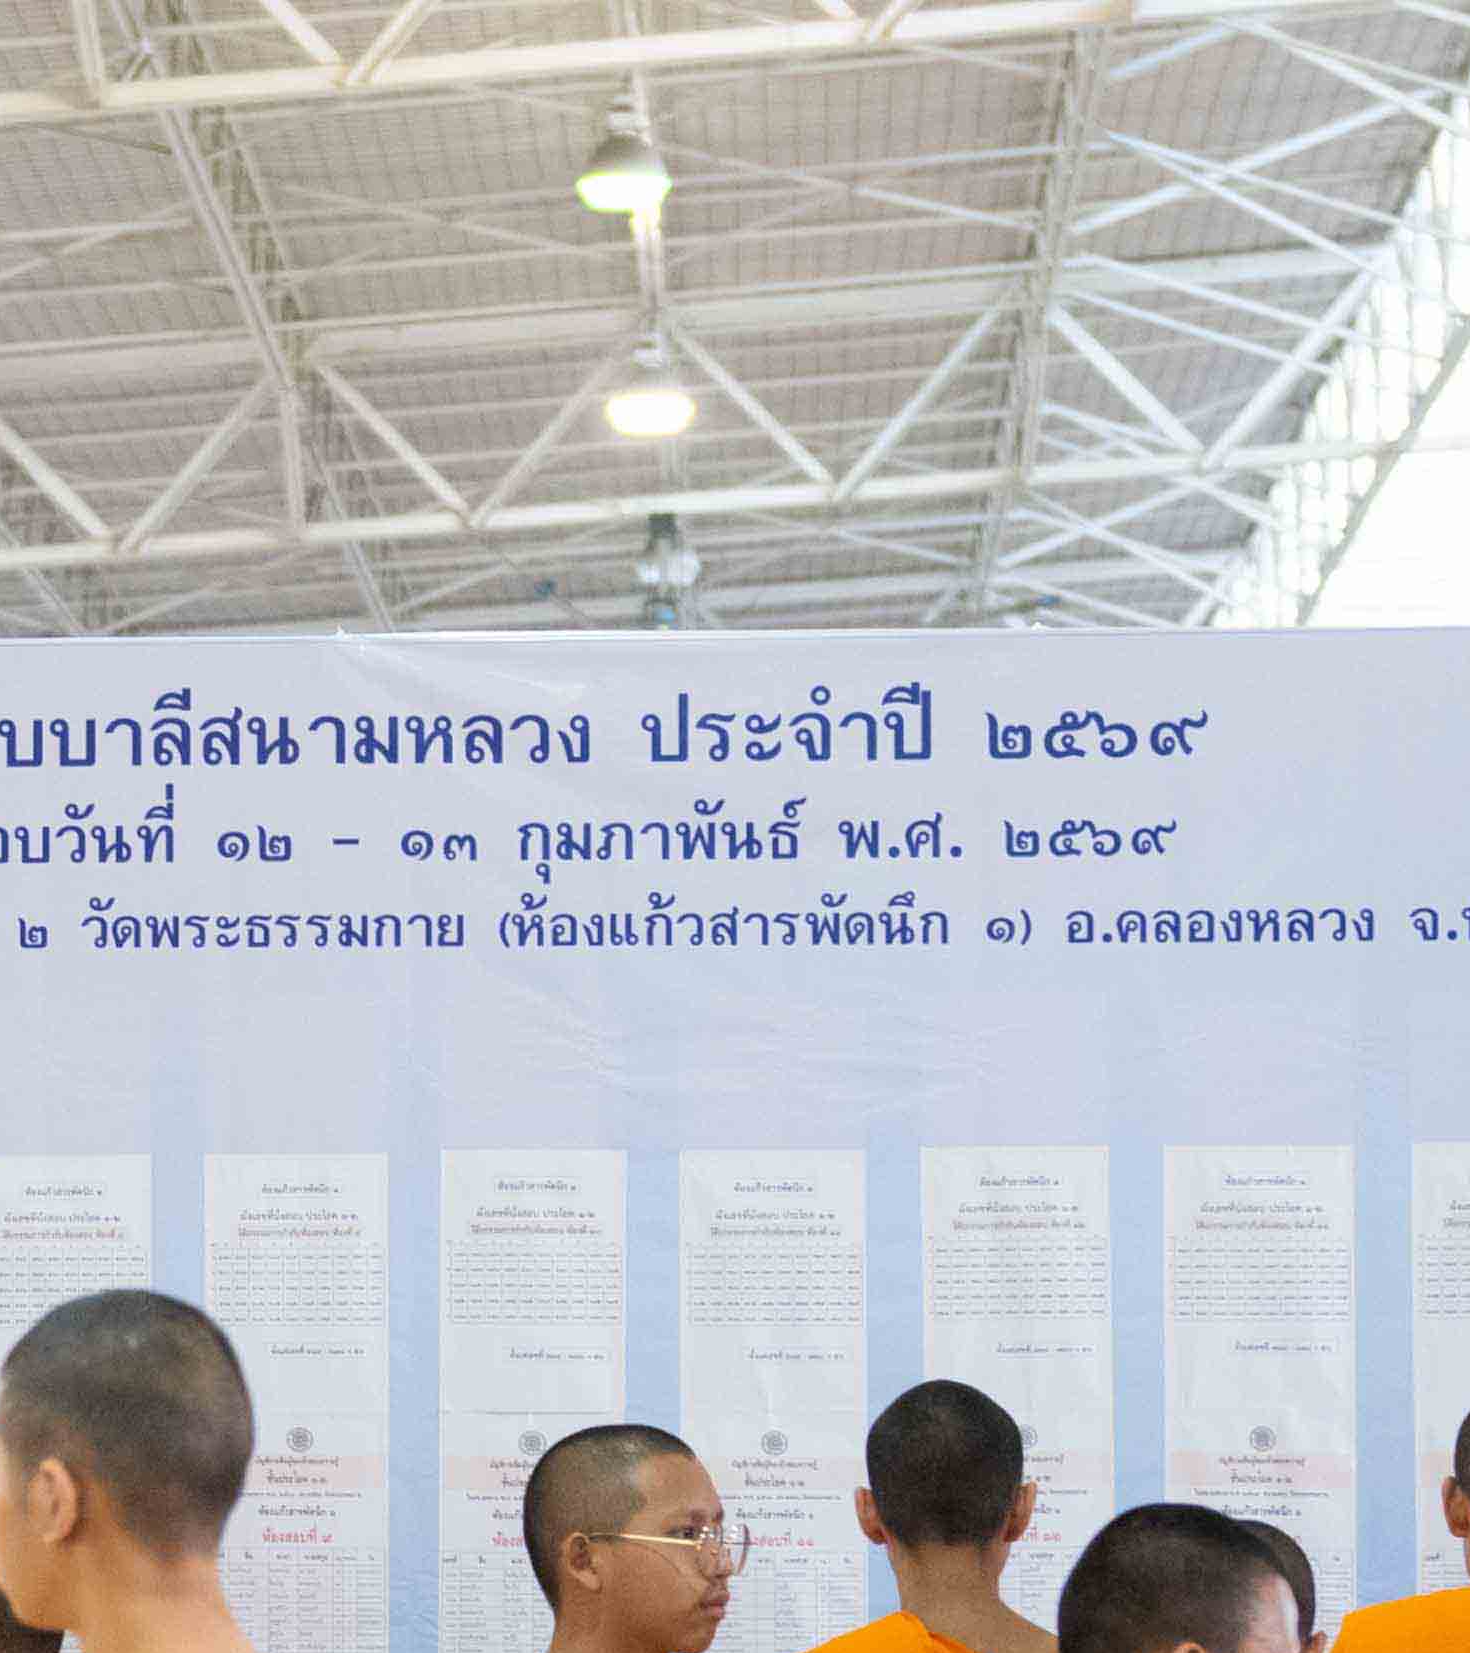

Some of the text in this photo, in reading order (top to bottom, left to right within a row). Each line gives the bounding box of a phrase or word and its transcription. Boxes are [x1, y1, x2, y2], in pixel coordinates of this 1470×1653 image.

[641, 682, 932, 762] ประจำปี
[986, 710, 1208, 759] ๒๕๖๙
[217, 825, 292, 862] ๑๒
[401, 830, 477, 861] ๑๓
[518, 797, 807, 884] กุมภาพันธ์
[838, 812, 962, 858] พ.ศ.
[1004, 820, 1177, 857] ๒๕๖๙
[18, 918, 48, 949] ๒
[81, 897, 464, 948] วัดพระธรรมกาย
[499, 891, 948, 948] (ห้องแก้วสารพัดนึก
[986, 909, 1032, 945] ๑)
[1066, 908, 1374, 943] อ.คลองหลวง
